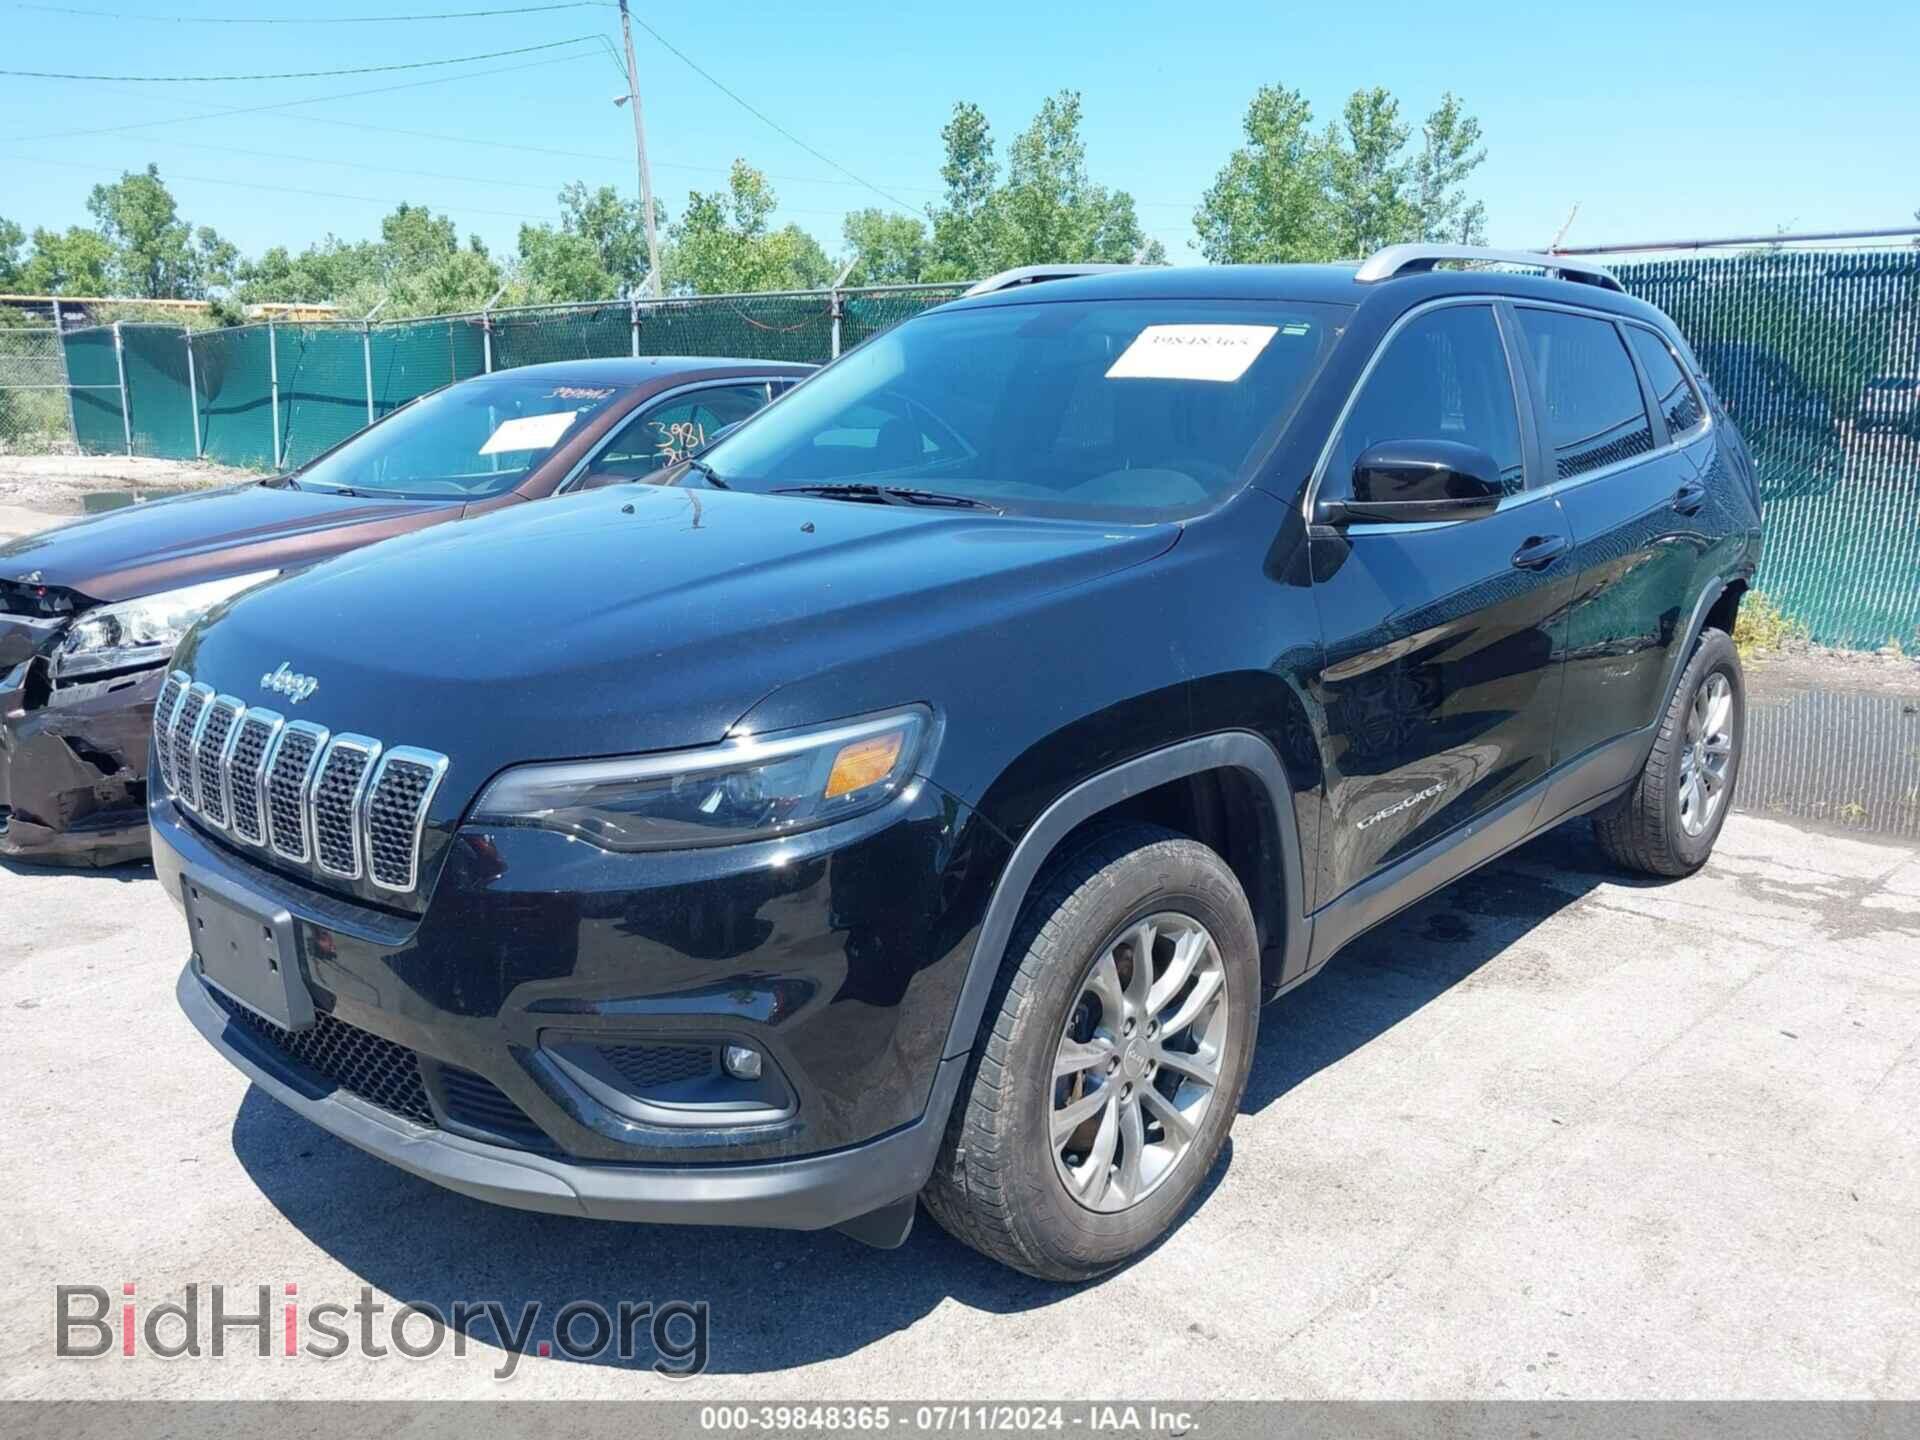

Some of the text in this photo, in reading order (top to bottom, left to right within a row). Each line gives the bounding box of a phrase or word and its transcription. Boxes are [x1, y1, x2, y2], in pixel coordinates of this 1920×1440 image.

[647, 421, 705, 449] 3981
[260, 661, 319, 705] Jeep
[1356, 781, 1449, 830] CHEROKEE
